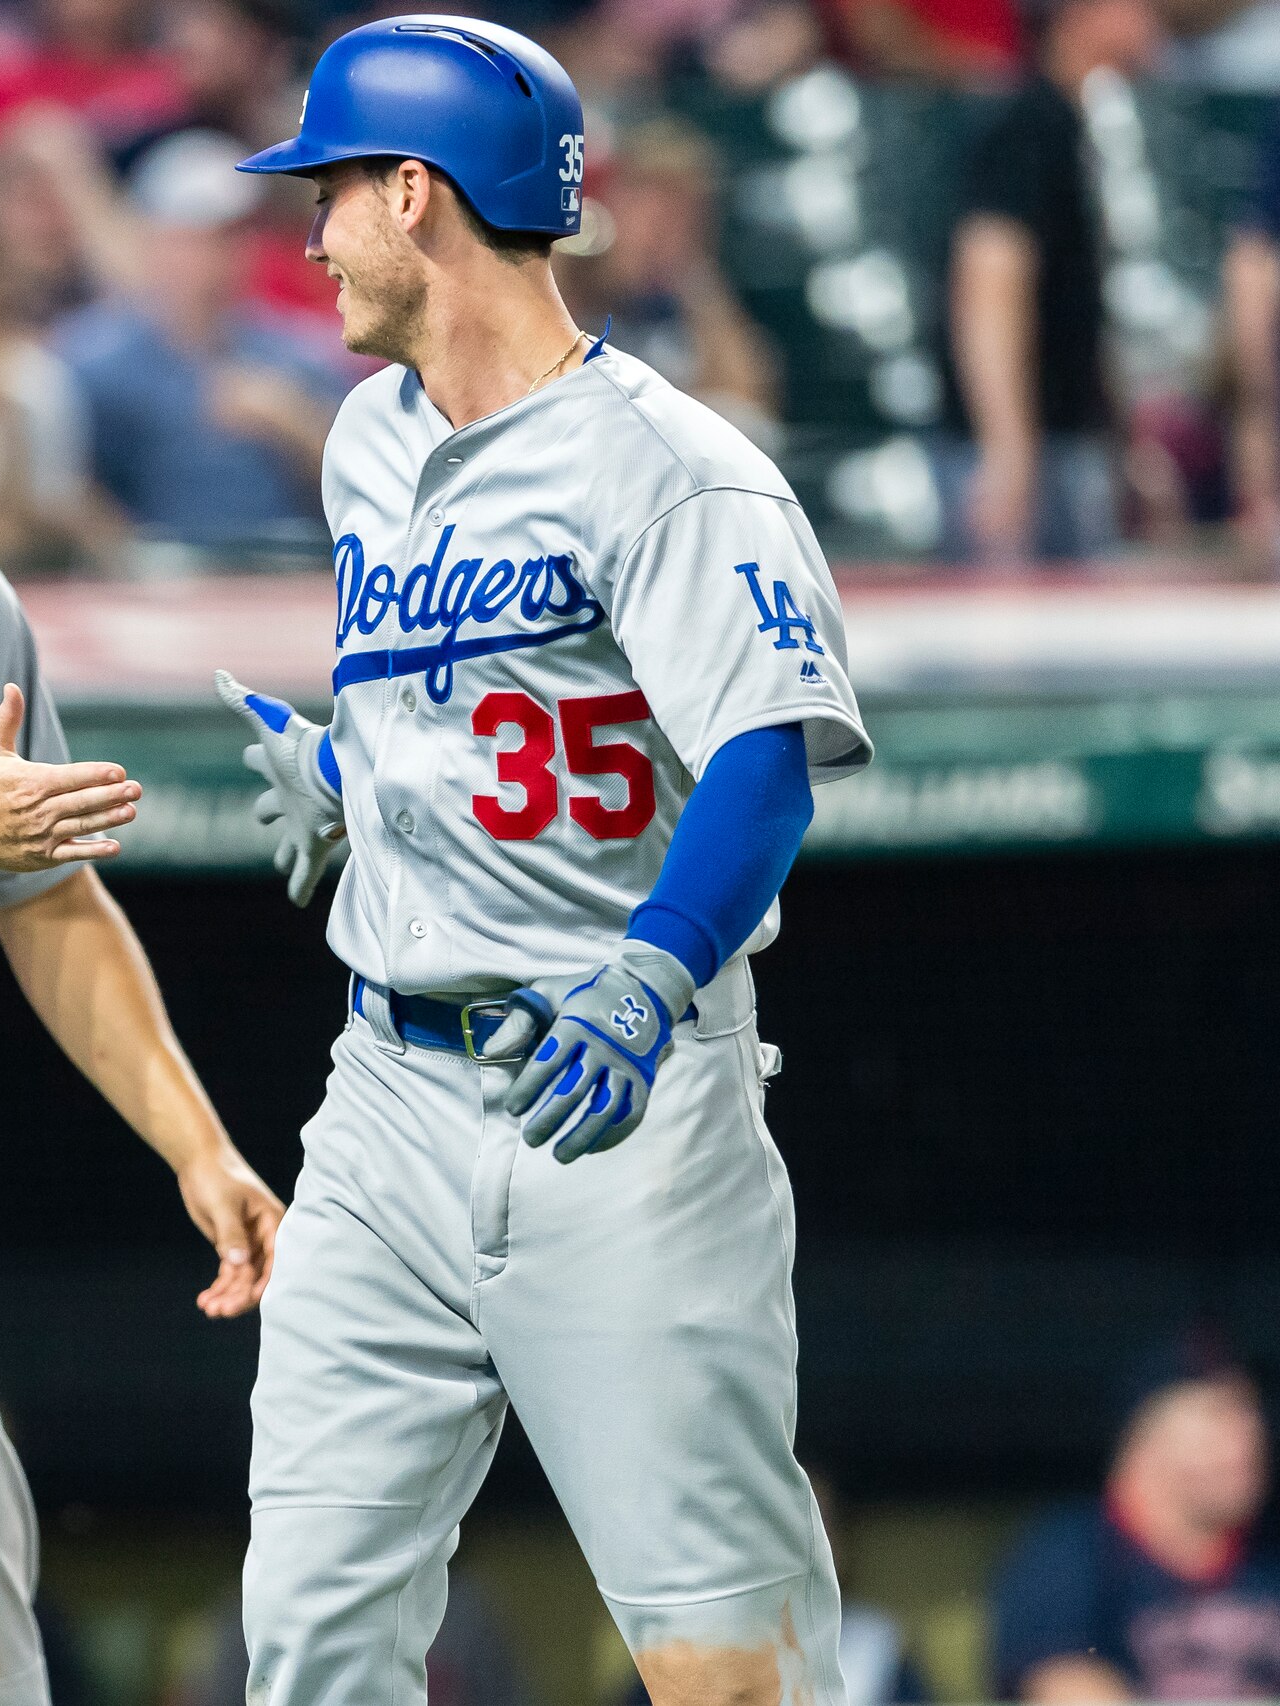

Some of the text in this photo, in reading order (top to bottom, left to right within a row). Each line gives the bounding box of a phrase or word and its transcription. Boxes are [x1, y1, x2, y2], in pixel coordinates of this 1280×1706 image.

[559, 134, 584, 183] 35
[333, 524, 605, 704] Dodgers
[733, 562, 825, 656] LA
[472, 690, 657, 840] 35
